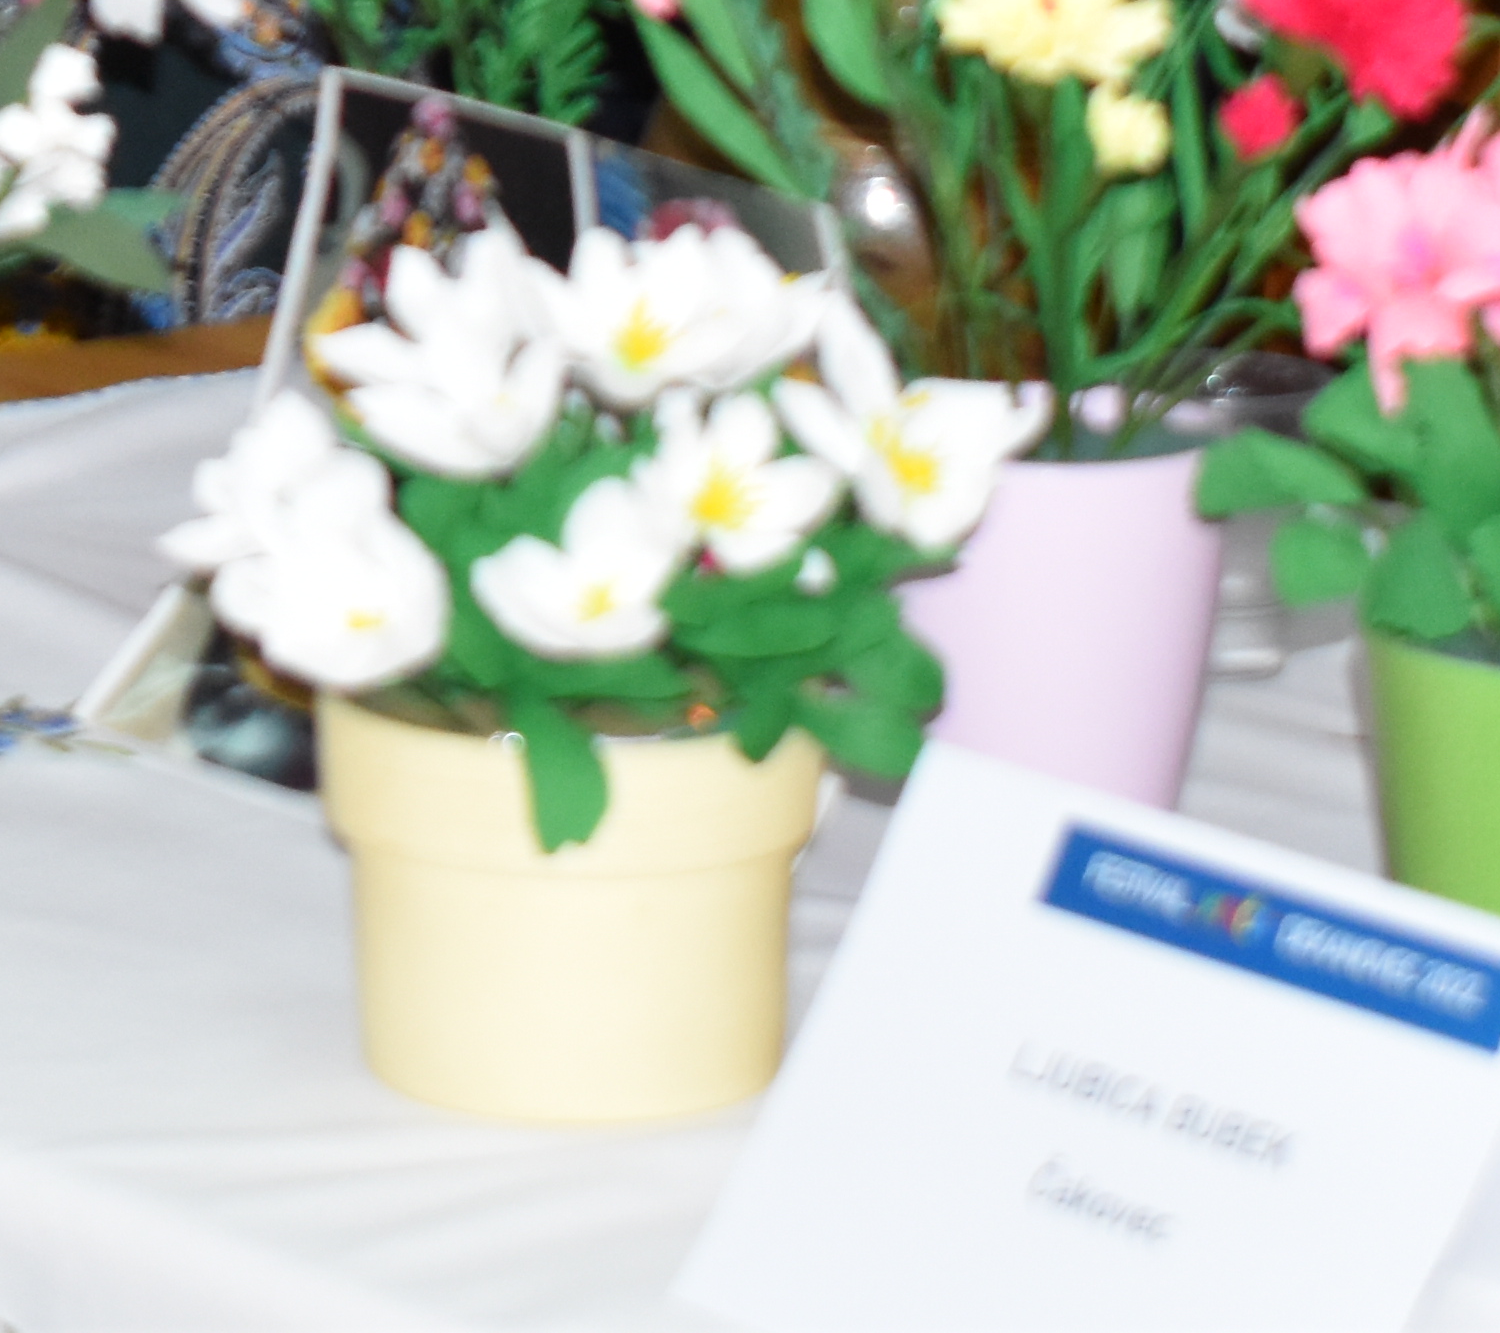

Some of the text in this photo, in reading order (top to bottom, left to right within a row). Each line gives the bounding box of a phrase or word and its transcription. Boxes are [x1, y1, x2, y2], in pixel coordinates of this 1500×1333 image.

[1080, 849, 1194, 925] FESTIVAL
[1007, 1035, 1158, 1129] LJUBICA
[1024, 1149, 1176, 1241] Čakovec
